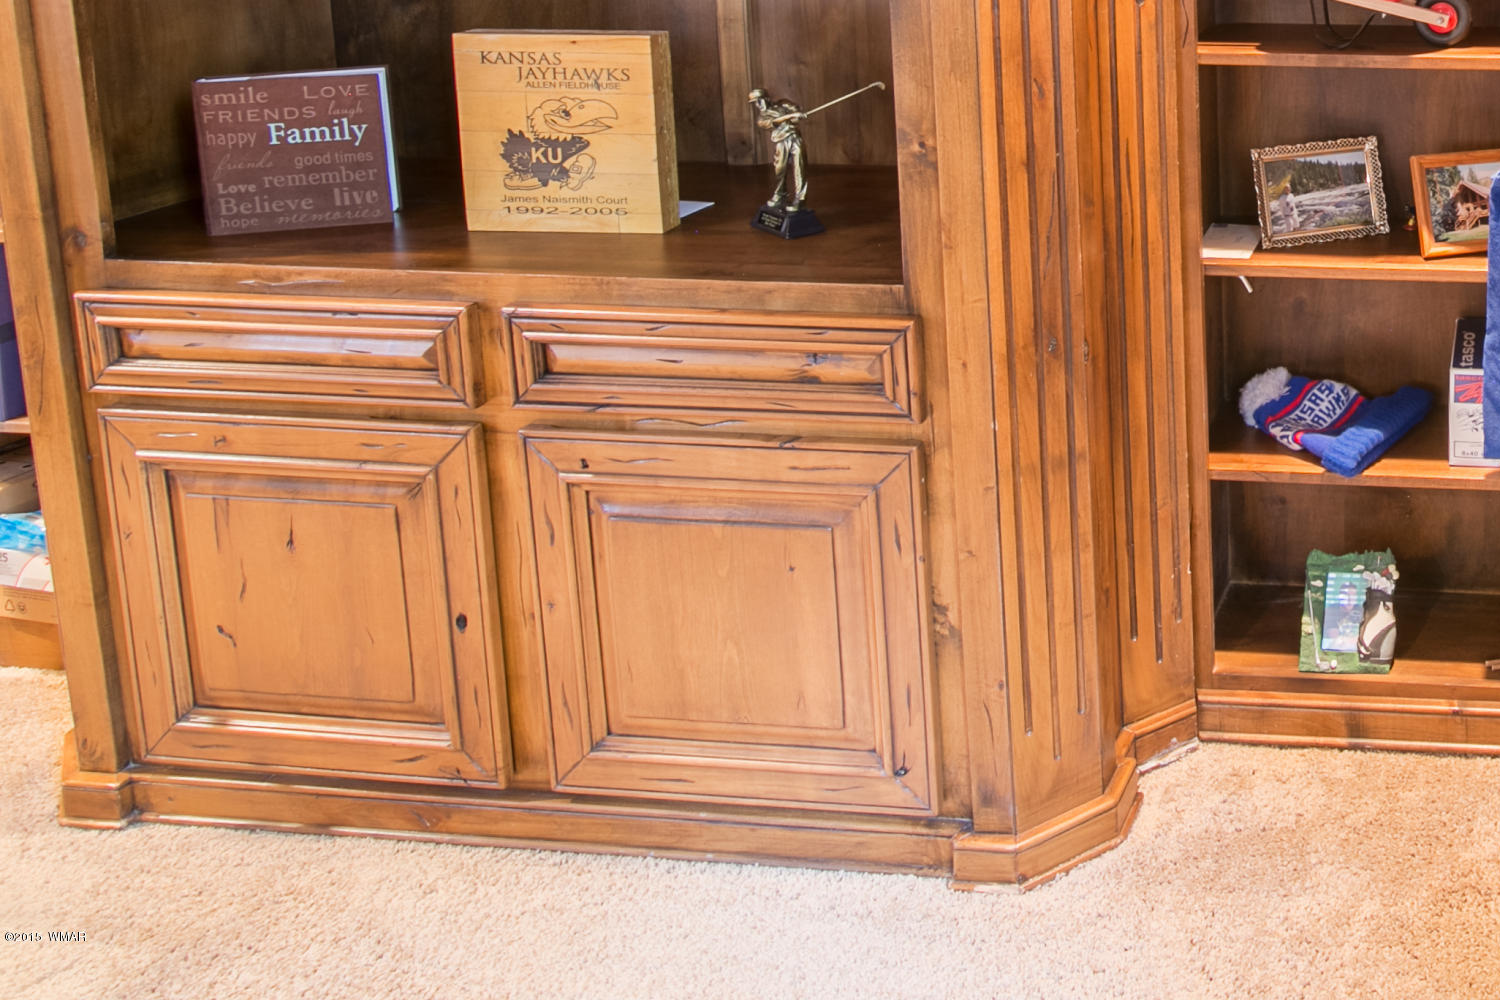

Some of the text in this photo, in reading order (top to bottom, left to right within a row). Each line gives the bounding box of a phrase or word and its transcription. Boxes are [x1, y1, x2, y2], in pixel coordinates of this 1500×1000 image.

[480, 51, 562, 66] KANSAS
[516, 67, 631, 83] JAYHAWKS
[303, 83, 369, 99] LOVE
[525, 80, 621, 90] ALLEN FIELDHOUSE
[201, 86, 269, 106] smile
[202, 106, 317, 124] FRIENDS
[328, 100, 364, 118] laugh
[205, 131, 256, 149] happy
[266, 117, 368, 147] Family
[294, 151, 374, 169] good times
[531, 147, 563, 164] KU
[262, 166, 378, 188] remember
[217, 182, 257, 195] Love
[333, 187, 379, 207] live
[217, 195, 314, 216] Believe
[501, 194, 628, 206] James Naismith Court
[503, 206, 629, 216] 1992-2005
[220, 217, 259, 229] hope
[1460, 331, 1476, 368] tasco
